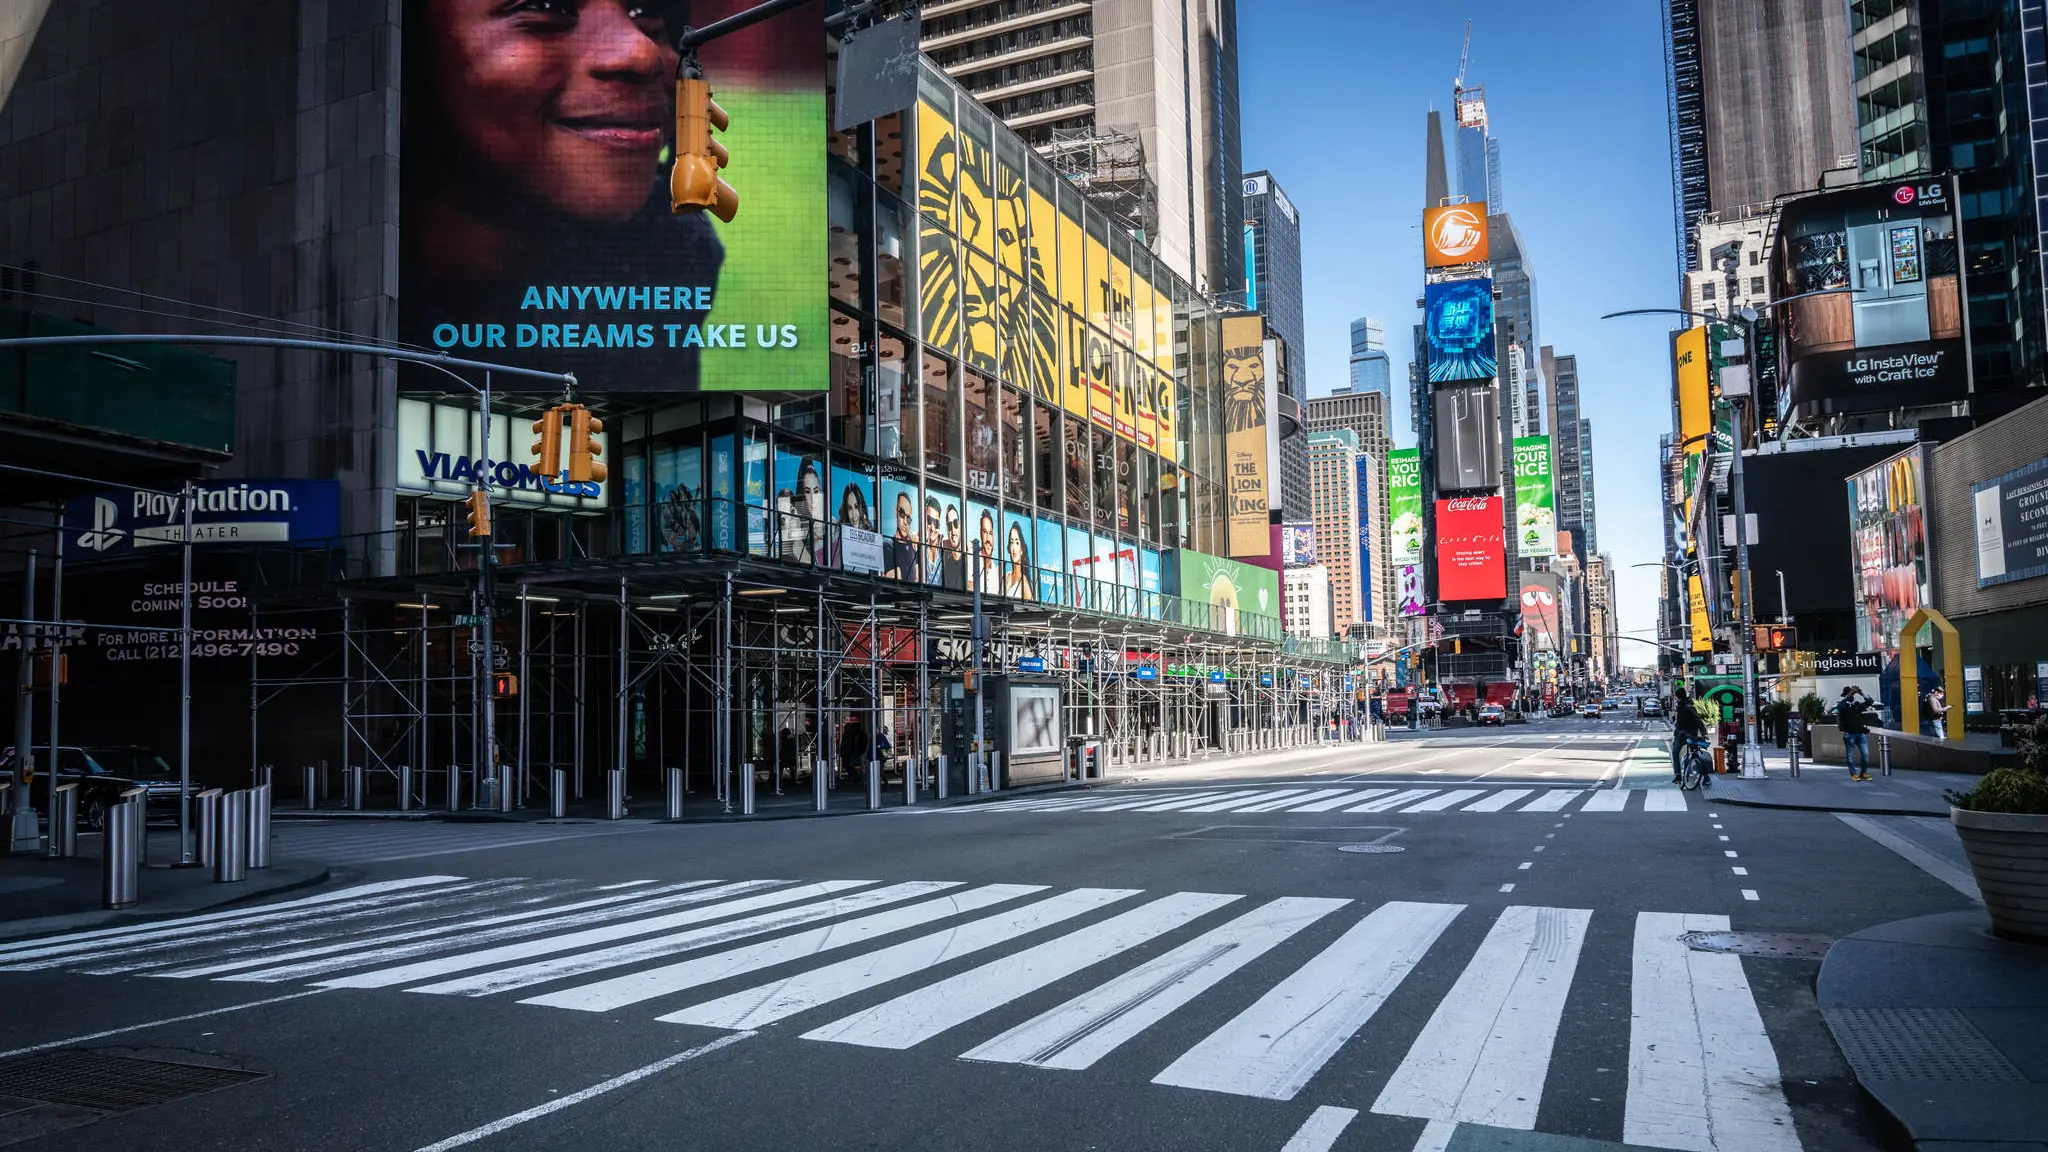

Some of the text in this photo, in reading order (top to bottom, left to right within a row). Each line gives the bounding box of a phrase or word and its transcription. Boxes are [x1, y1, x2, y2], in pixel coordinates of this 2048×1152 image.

[1918, 184, 1942, 200] LG
[521, 286, 711, 310] ANYWHERE
[433, 324, 798, 348] OUR DREAMS TAKE US
[1847, 360, 1868, 373] LG
[1855, 374, 1876, 384] with
[1877, 368, 1913, 382] Craft
[1234, 462, 1256, 474] THE
[1231, 476, 1262, 494] LION
[133, 483, 290, 524] PlayStation
[1230, 495, 1266, 517] KING
[1447, 496, 1489, 512] Coca-Cola
[164, 526, 238, 540] THATER
[143, 581, 237, 596] SCHEDULE
[97, 632, 124, 646] FOR
[127, 632, 168, 644] MORE
[106, 648, 142, 660] CALL
[191, 643, 300, 657] 496-7490
[1800, 656, 1877, 671] sunglass hut
